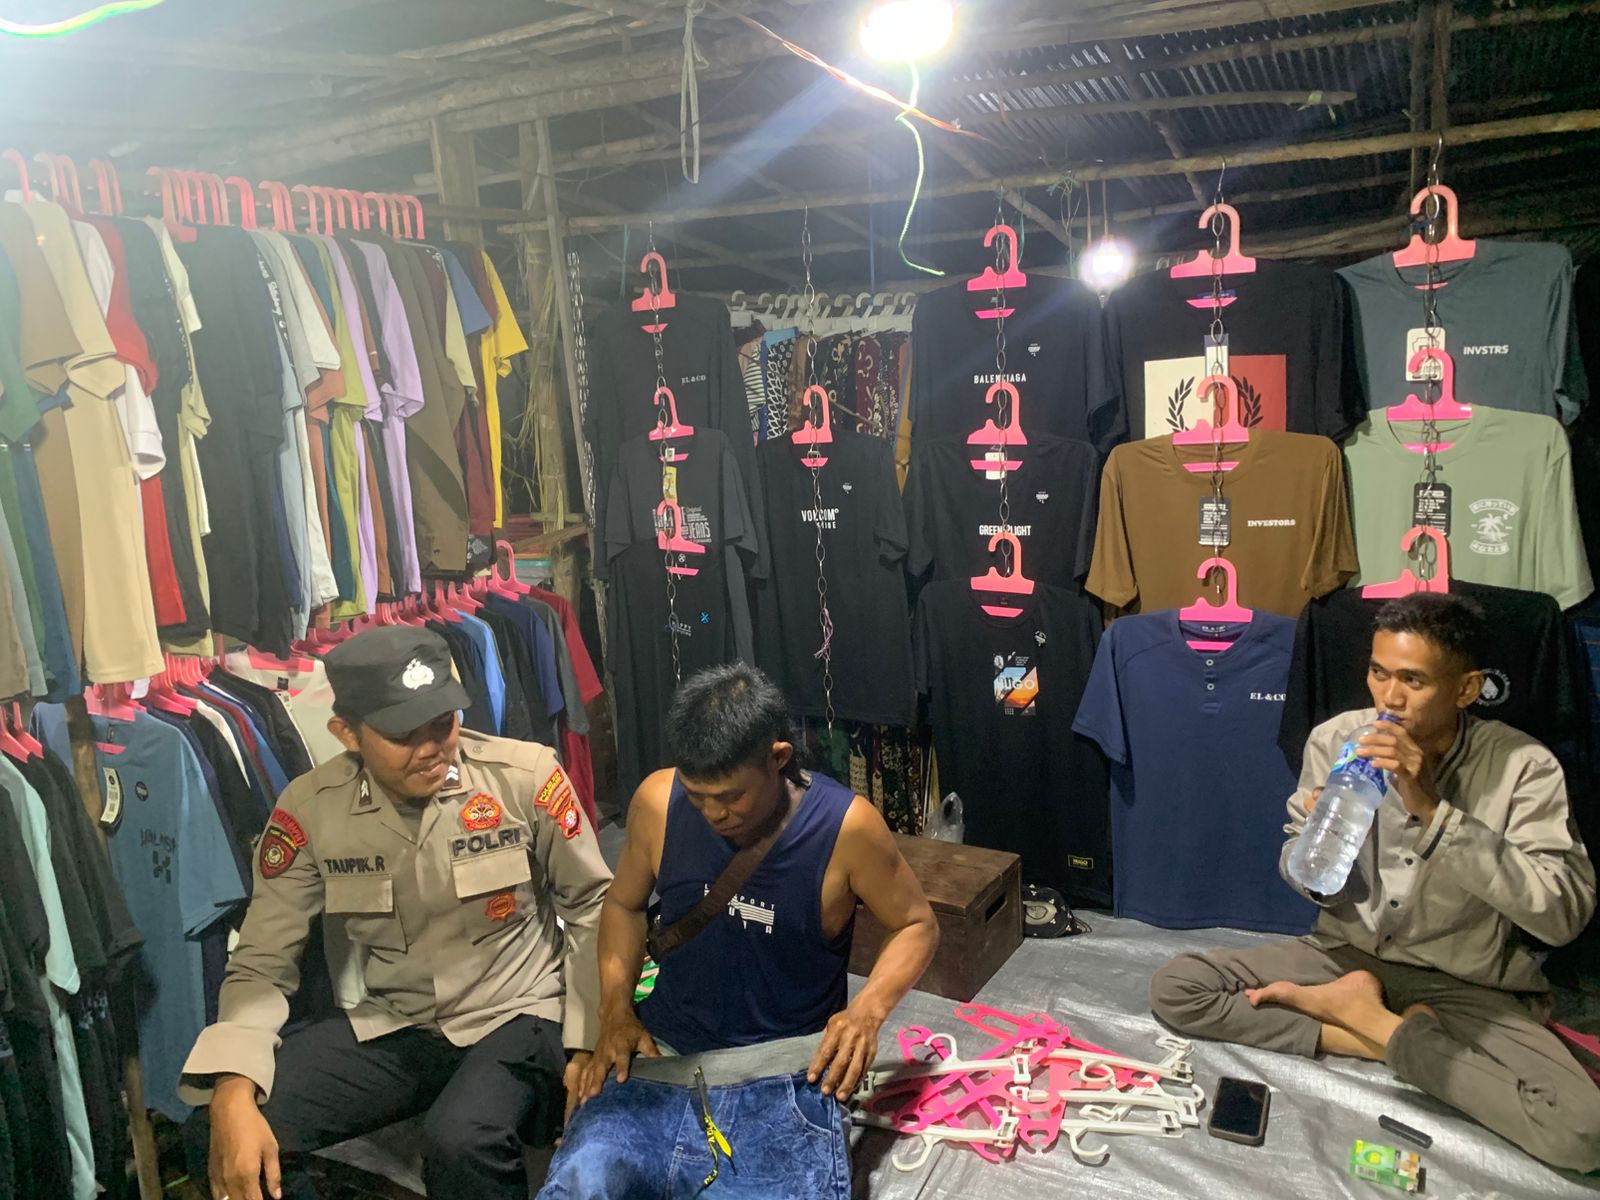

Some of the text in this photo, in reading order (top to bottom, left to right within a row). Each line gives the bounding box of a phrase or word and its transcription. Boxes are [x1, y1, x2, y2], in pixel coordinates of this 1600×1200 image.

[1463, 345, 1509, 355] INVSTRS
[1247, 519, 1296, 527] INVESTORS
[452, 828, 521, 857] POLRI
